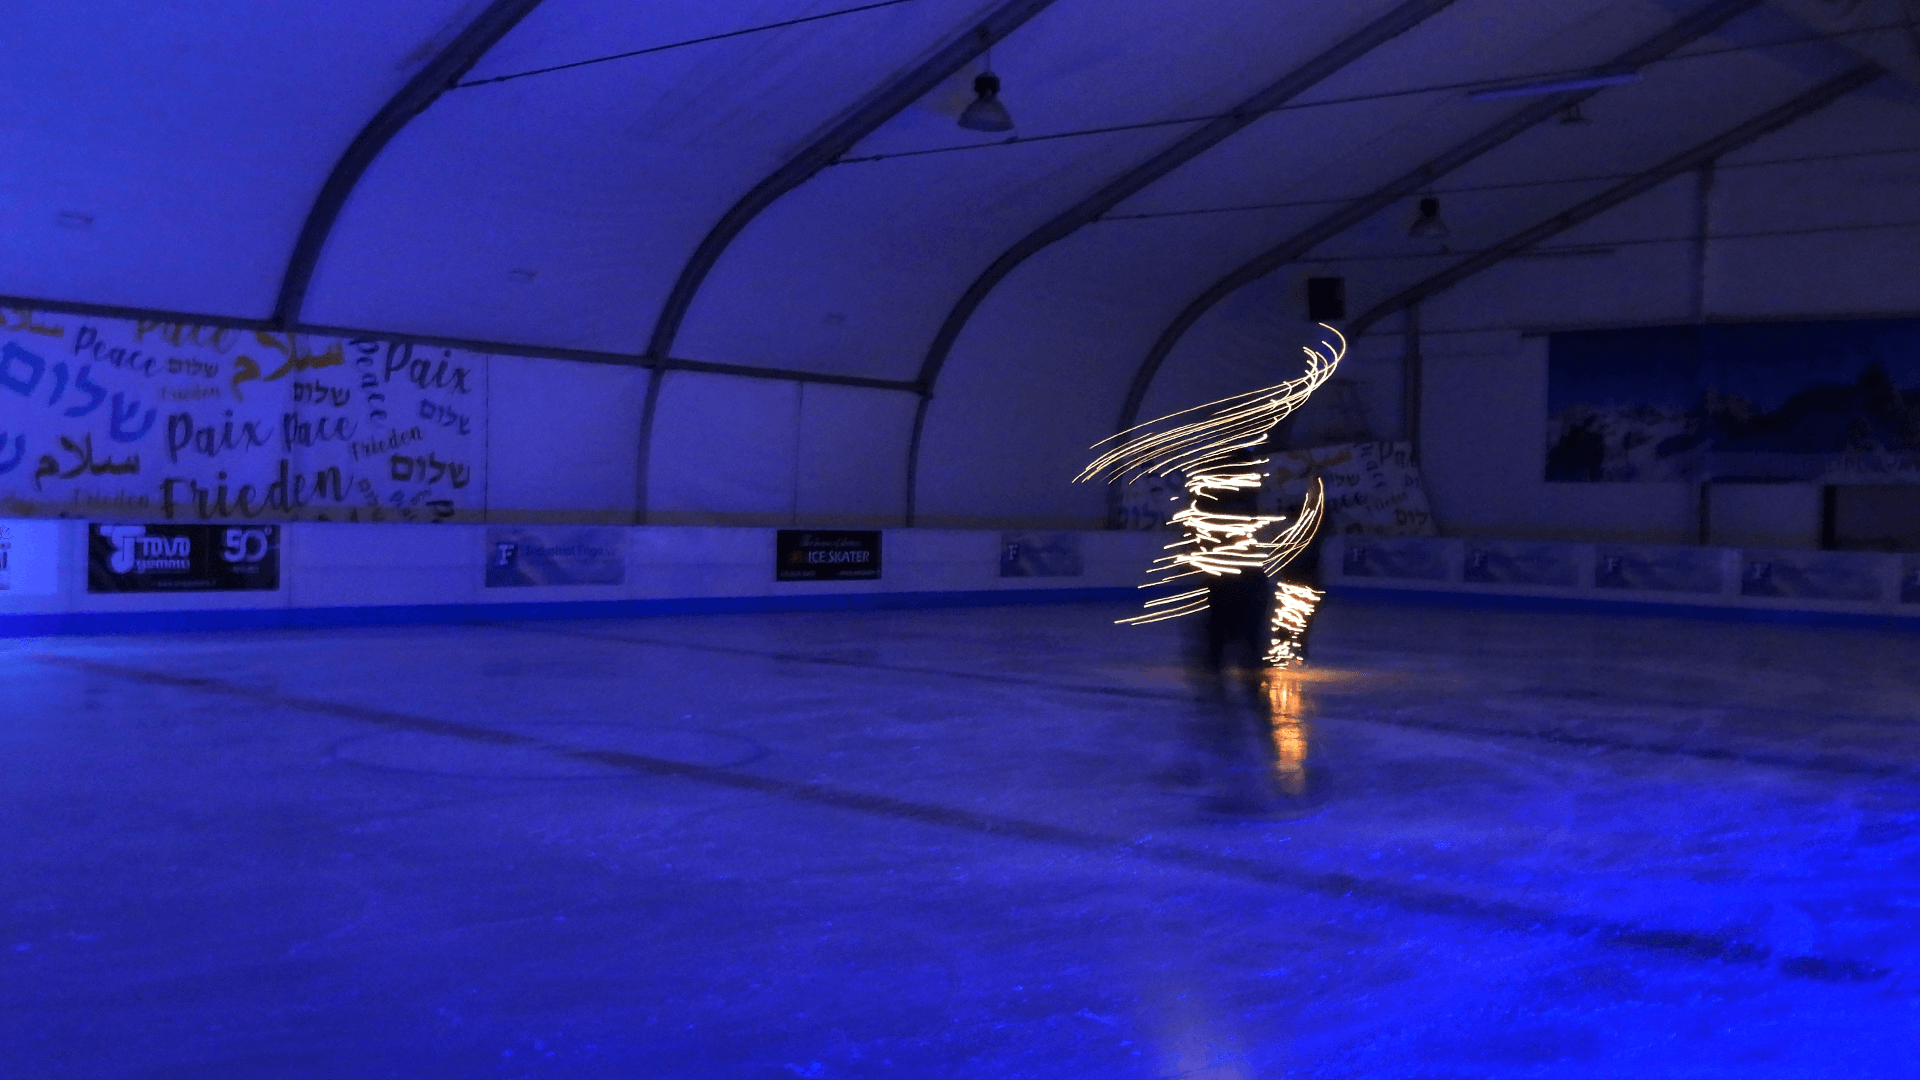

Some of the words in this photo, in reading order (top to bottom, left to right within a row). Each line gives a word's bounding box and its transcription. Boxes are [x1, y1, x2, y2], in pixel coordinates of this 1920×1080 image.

[75, 325, 164, 378] Peace
[232, 331, 345, 402] سلام
[384, 337, 471, 395] Paix
[0, 341, 157, 443] שלום
[294, 379, 350, 408] שלום
[419, 398, 471, 436] שלום
[35, 432, 140, 492] سلام
[167, 409, 273, 464] Paix
[282, 411, 358, 453] Pace
[159, 458, 354, 519] Frieden
[390, 451, 471, 489] שלום
[136, 536, 191, 557] TOVO
[808, 550, 826, 563] ICE
[828, 550, 870, 563] SKATER
